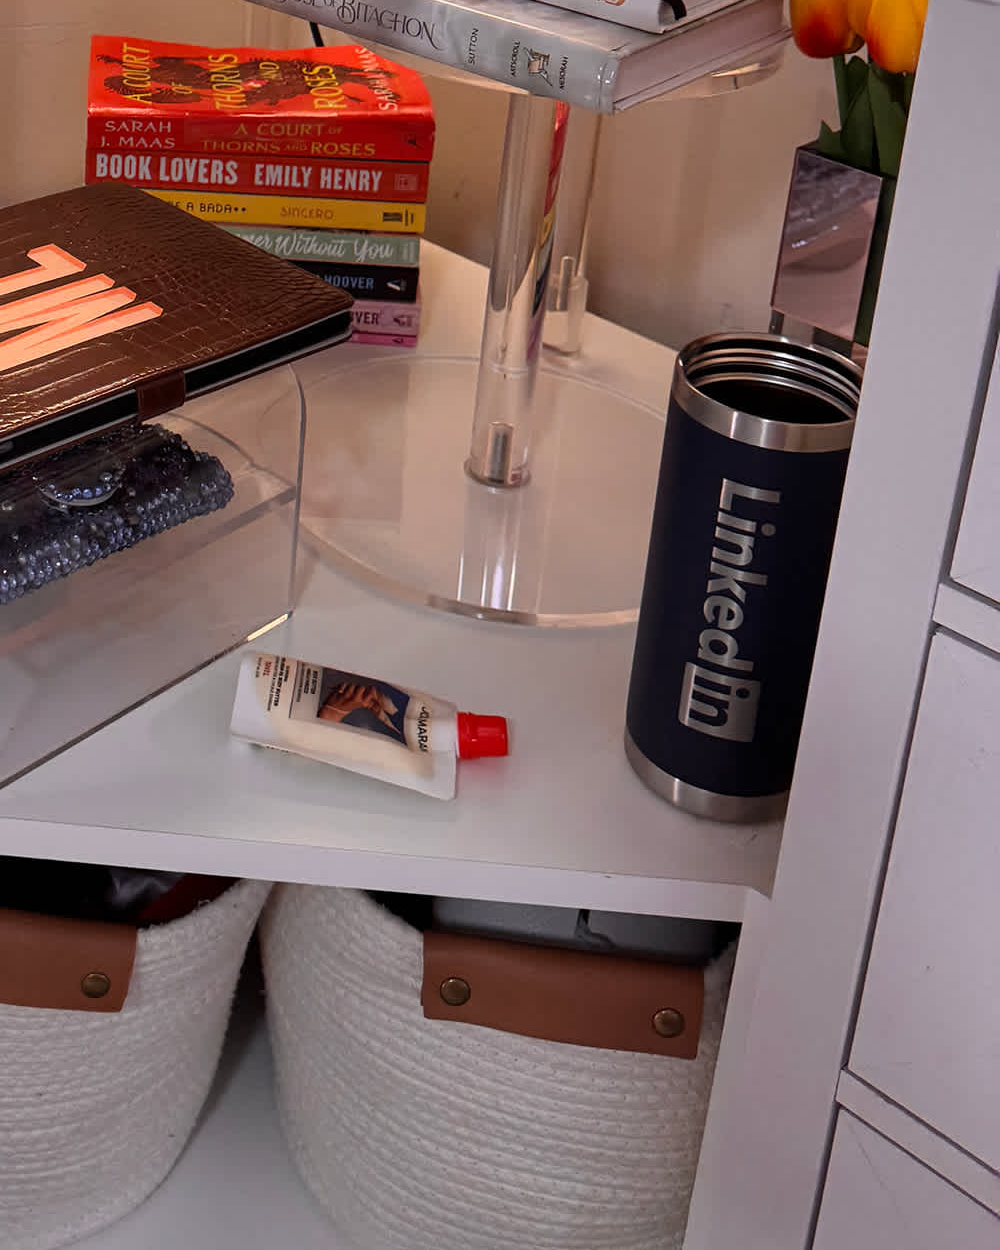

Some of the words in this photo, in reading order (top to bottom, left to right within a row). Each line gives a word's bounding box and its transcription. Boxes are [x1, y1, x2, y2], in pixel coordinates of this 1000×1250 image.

[468, 28, 479, 65] SUTTON
[122, 42, 151, 88] COURT
[259, 61, 283, 80] AND
[171, 82, 193, 95] OF
[208, 53, 248, 110] THORNS
[302, 65, 347, 109] ROSES
[122, 92, 152, 106] A
[105, 120, 172, 133] SARAH
[234, 123, 248, 136] A
[256, 122, 325, 137] COURT
[101, 136, 110, 147] J.
[119, 136, 176, 149] MAAS
[201, 140, 281, 154] THORNS
[311, 141, 376, 156] ROSES
[96, 153, 152, 181] BOOK
[159, 156, 239, 185] LOVERS
[254, 163, 313, 189] EMILY
[320, 167, 383, 192] HENRY
[186, 202, 194, 212] A
[280, 207, 334, 220] SINCERO
[275, 233, 346, 256] Without
[353, 236, 394, 263] You
[324, 273, 375, 290] HOOVER
